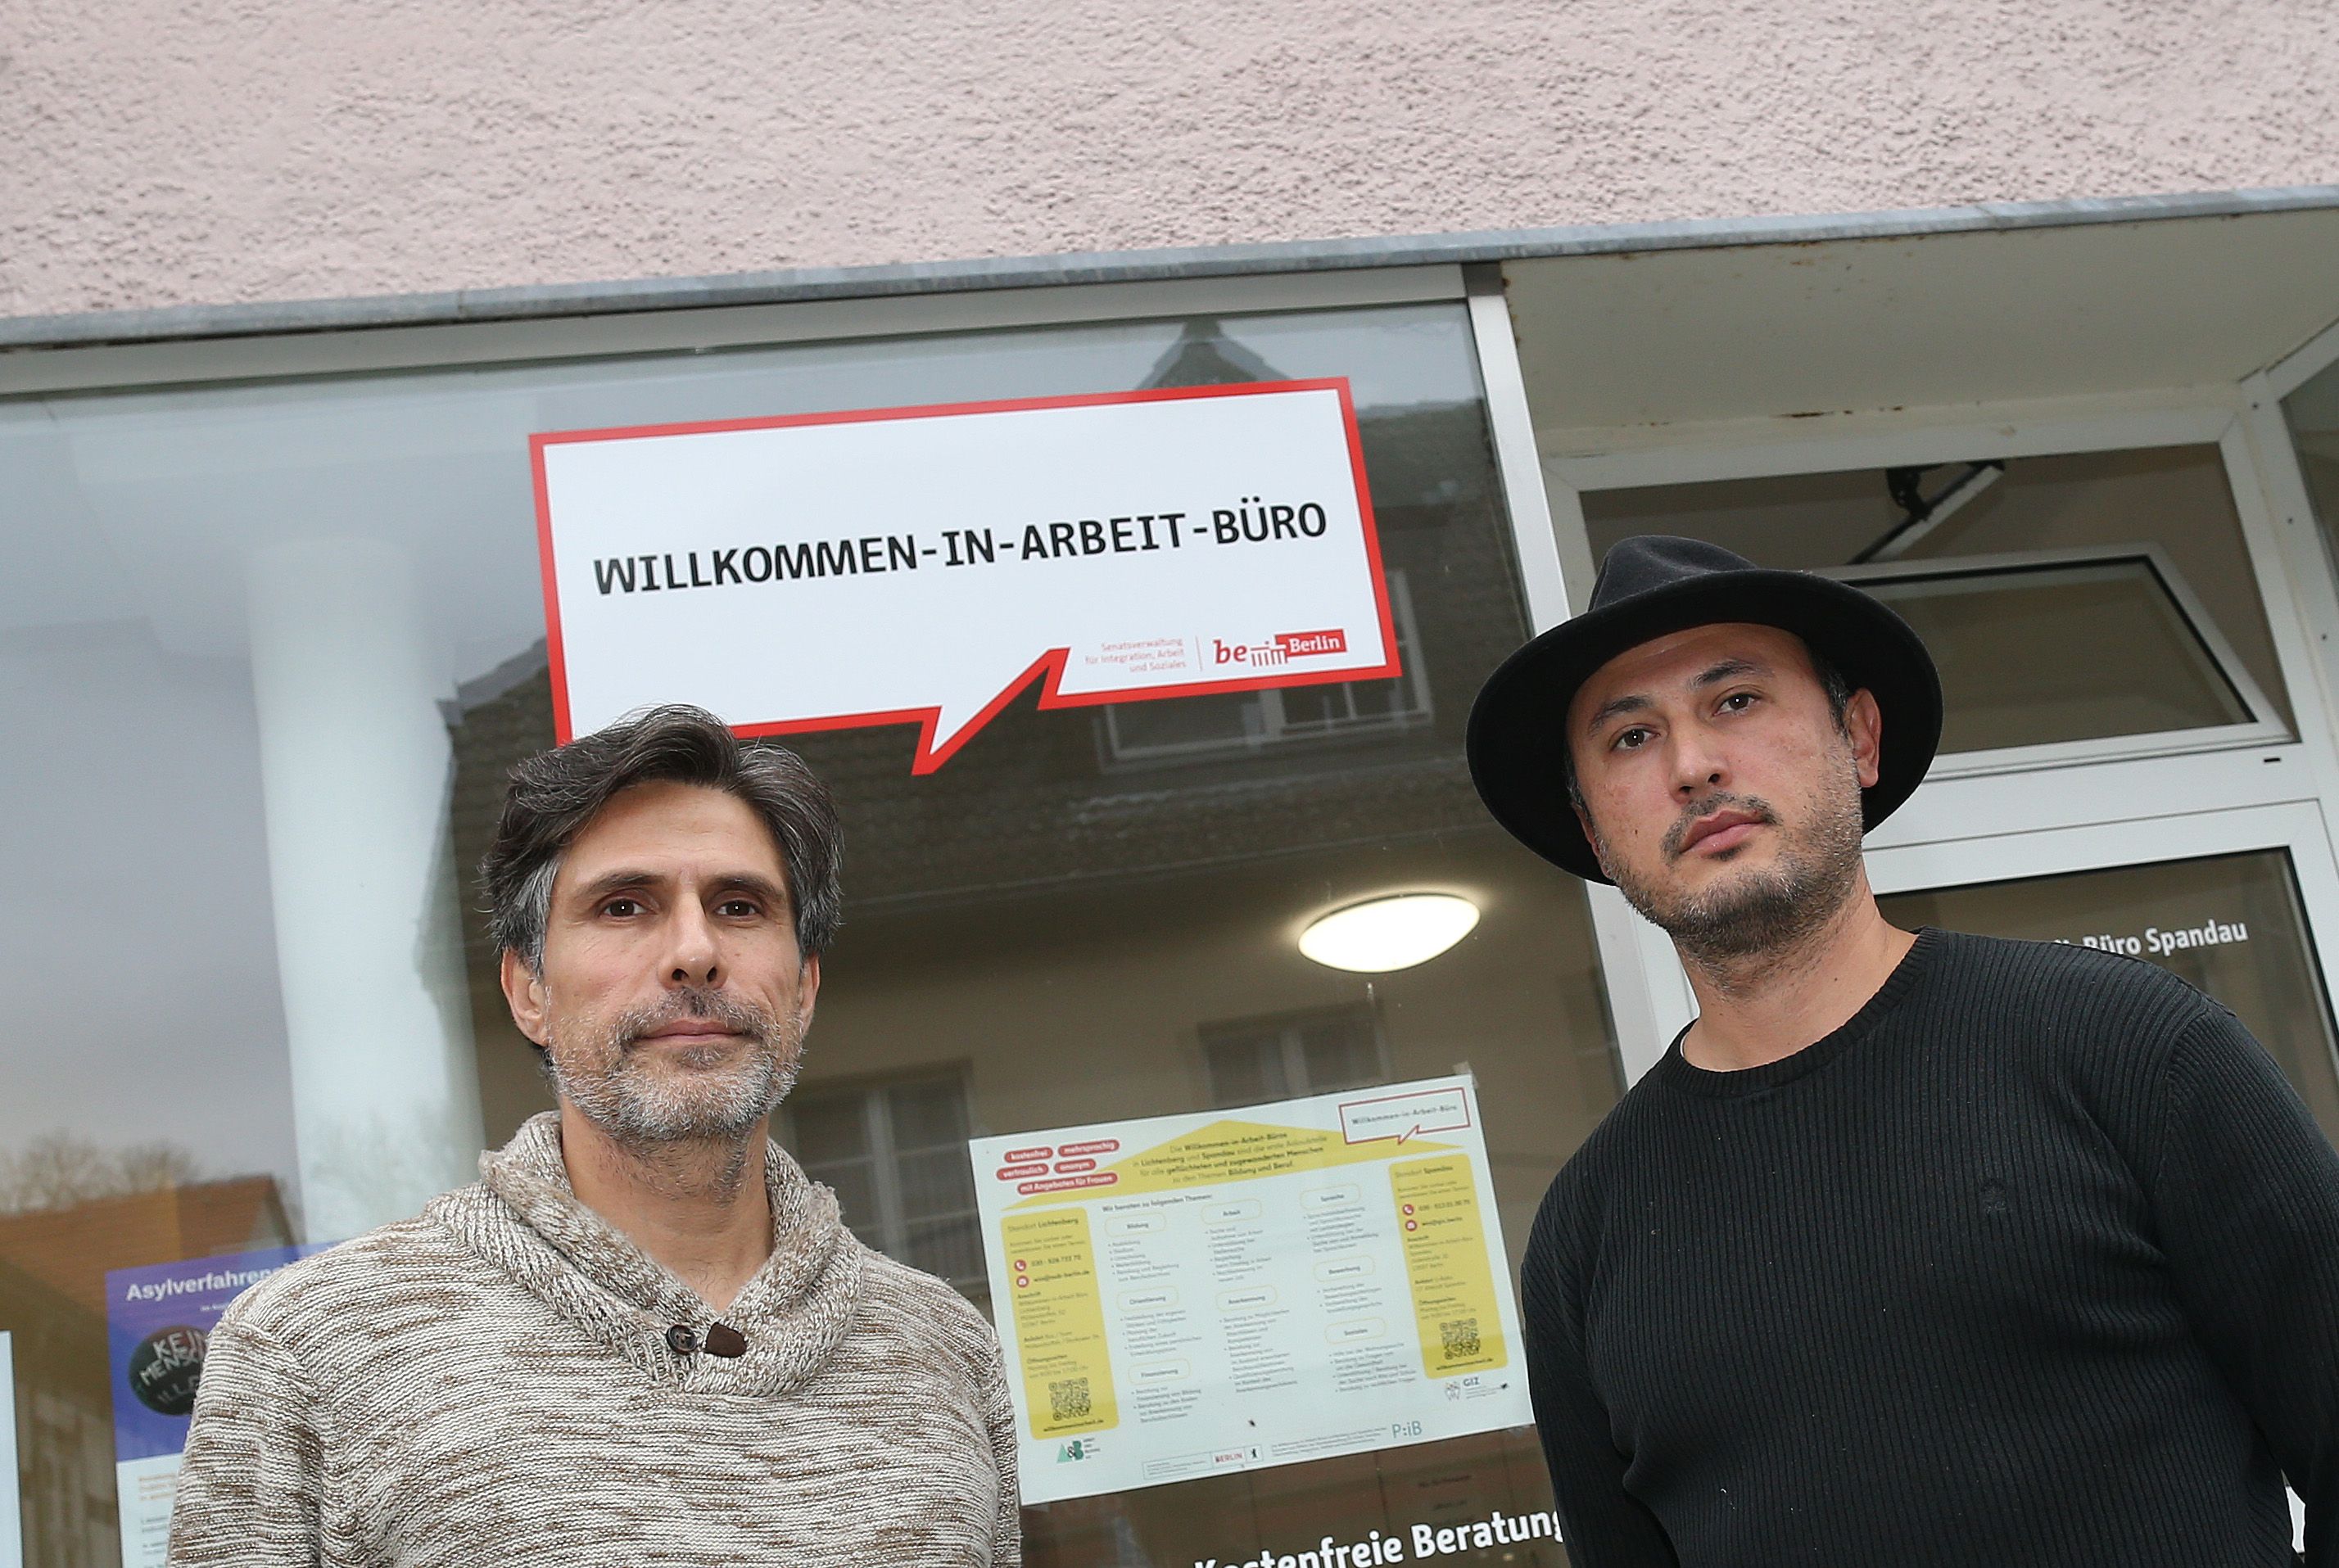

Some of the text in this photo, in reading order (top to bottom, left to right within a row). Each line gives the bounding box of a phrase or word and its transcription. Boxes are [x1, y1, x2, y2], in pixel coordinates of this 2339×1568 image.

[594, 496, 1327, 594] WILLKOMMEN-IN-ARBEIT-BÜRO
[1101, 638, 1183, 652] Senatsverwaltung
[1213, 634, 1341, 664] be Berlin
[1084, 656, 1098, 665] für
[1157, 648, 1184, 657] Arbeit
[1129, 660, 1186, 673] und Soziales
[2145, 919, 2249, 956] Spandau
[1010, 1148, 1049, 1160] kostenfrei
[1462, 1376, 1481, 1388] GIZ
[1215, 1451, 1243, 1463] BERLIN
[1194, 1529, 1404, 1568] tenfreie
